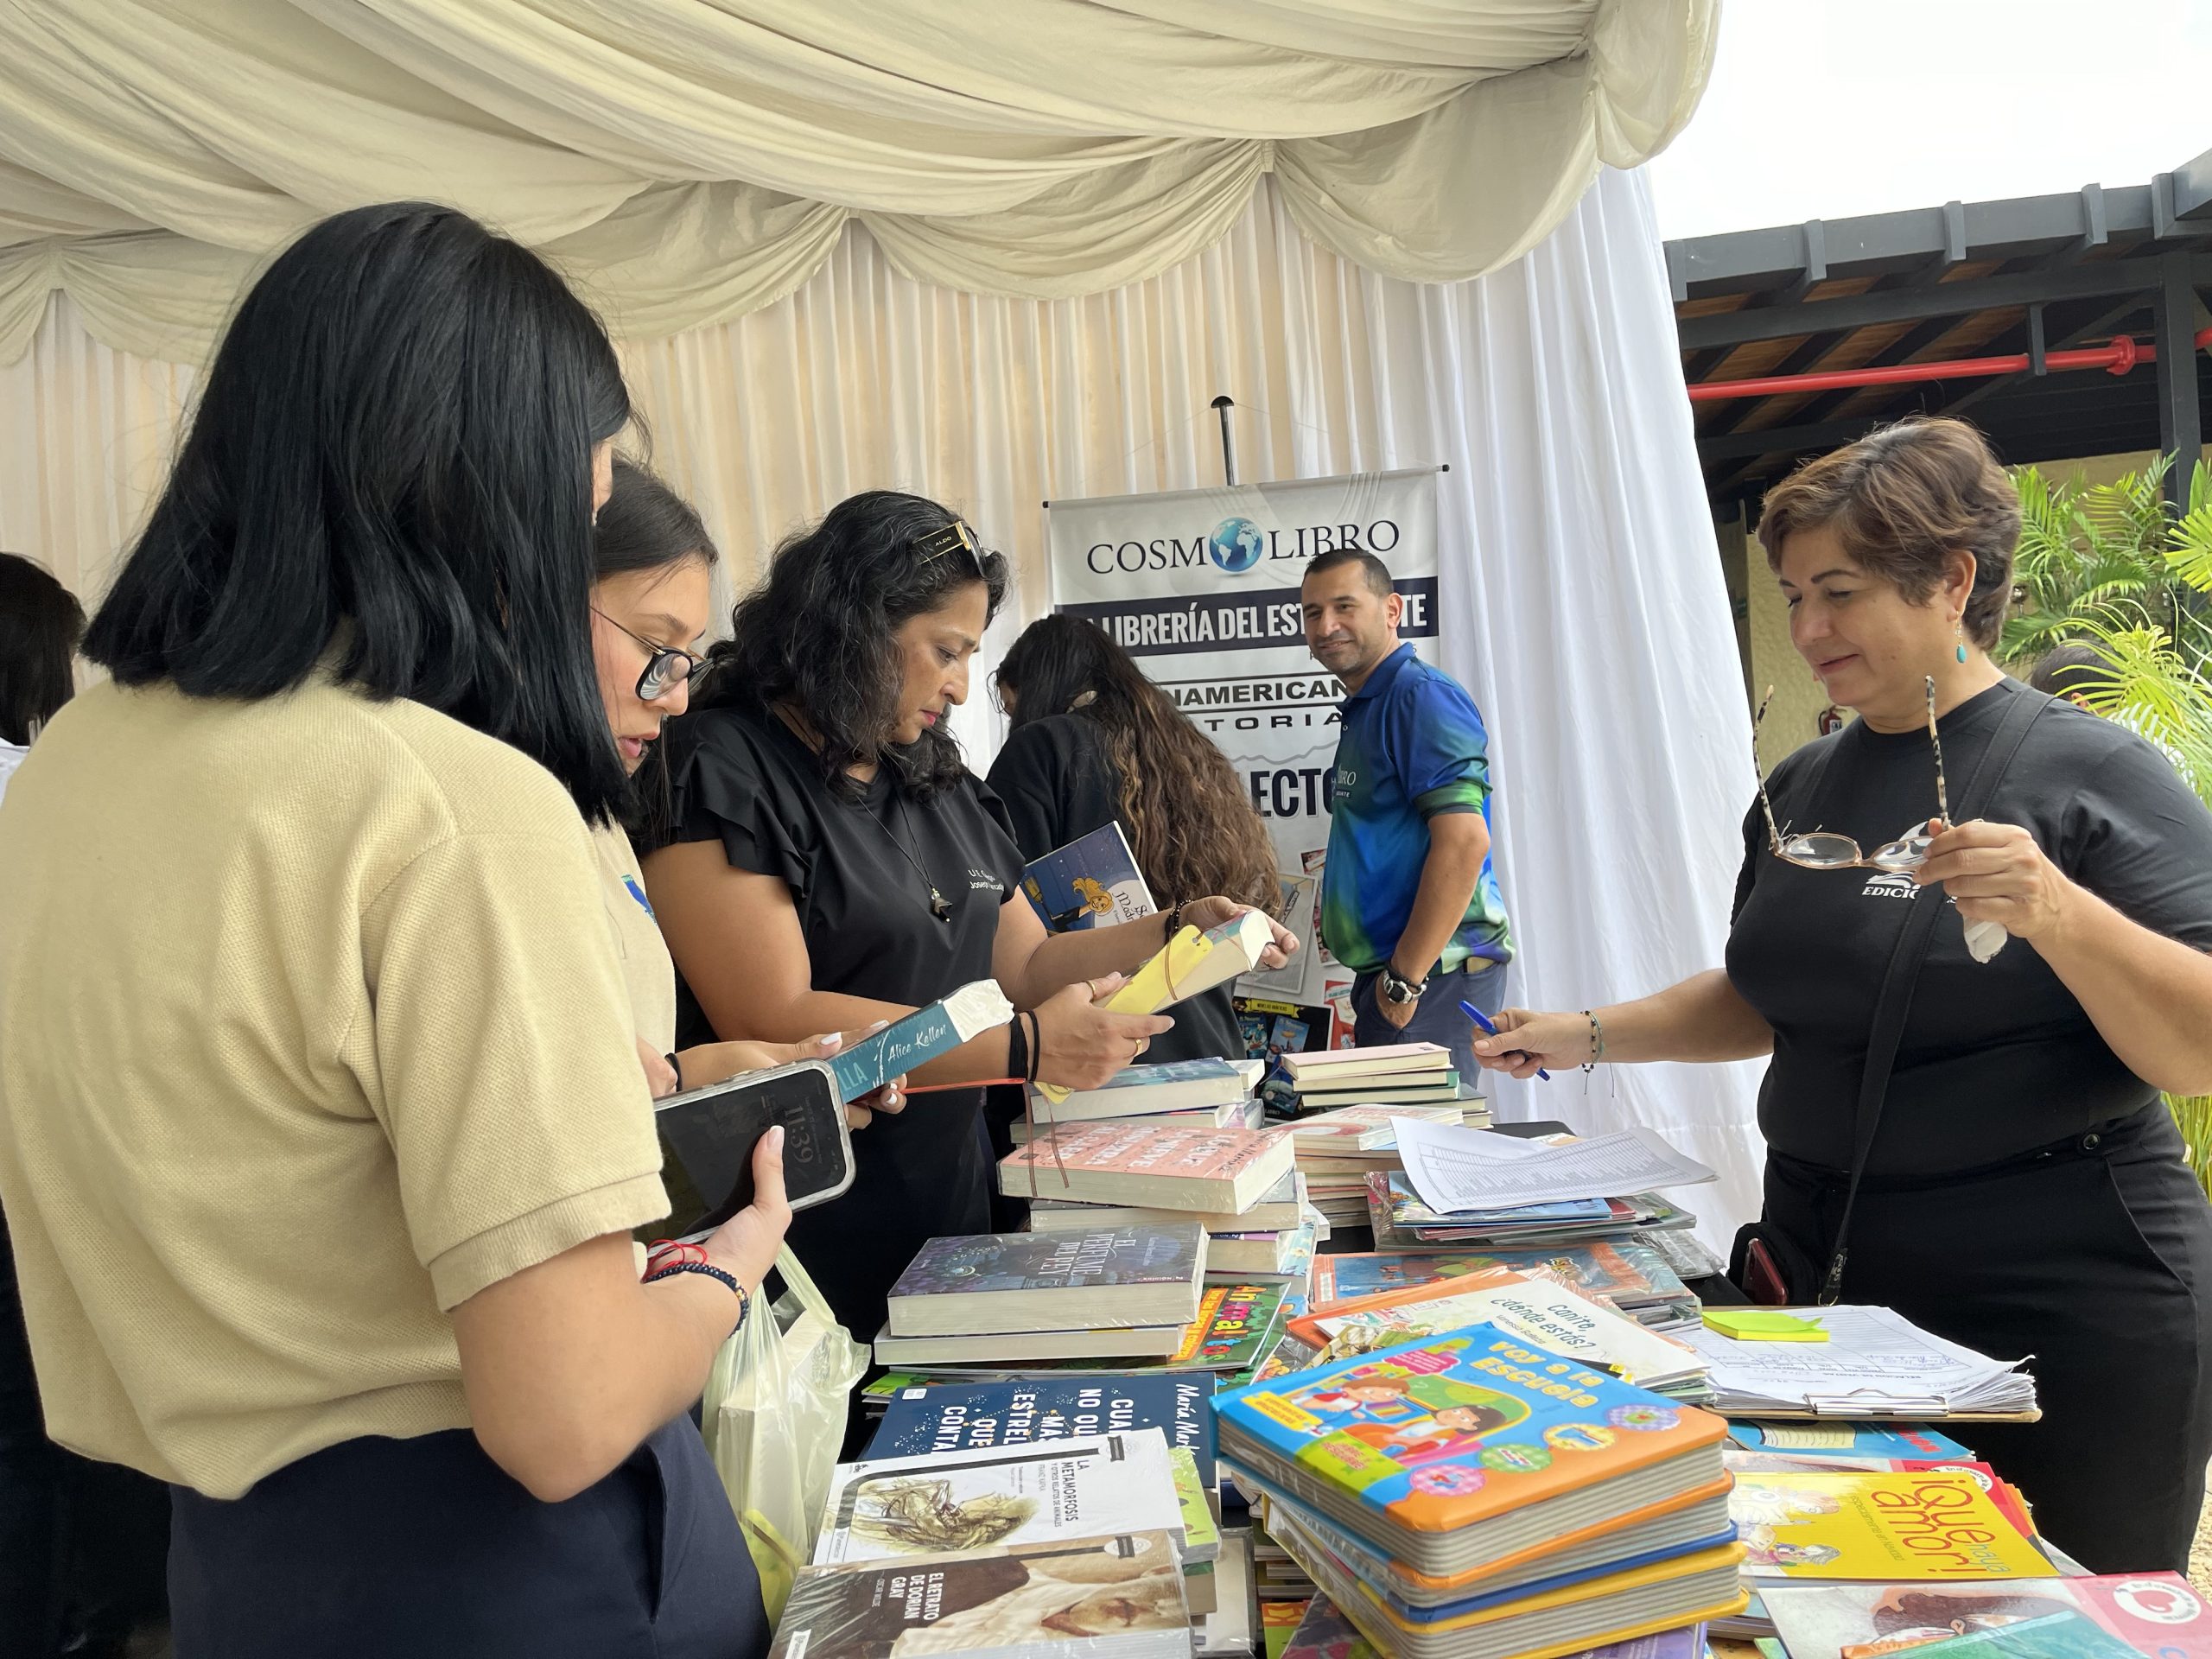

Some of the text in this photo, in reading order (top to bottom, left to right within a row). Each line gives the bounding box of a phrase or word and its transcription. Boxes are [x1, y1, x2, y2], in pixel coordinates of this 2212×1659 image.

[935, 536, 952, 547] ALDO
[1218, 606, 1264, 640] DEL
[887, 1024, 947, 1062] Alice Kellen
[785, 1106, 814, 1163] 11:39
[1038, 1242, 1081, 1275] DEL REY
[1071, 1233, 1116, 1276] PERFUME
[1113, 1238, 1137, 1249] EL
[1203, 1300, 1217, 1309] las
[1490, 1298, 1597, 1350] ¿dónde estás?
[1470, 1356, 1599, 1408] Escuela
[1567, 1371, 1605, 1388] la
[1077, 1388, 1103, 1408] NO
[1175, 1383, 1200, 1420] María
[1003, 1393, 1037, 1445] ESTREL
[1038, 1415, 1070, 1441] MÁ
[1109, 1398, 1135, 1433] CUA
[968, 1418, 998, 1447] QUE
[1051, 1466, 1059, 1480] OTROS
[1077, 1459, 1090, 1471] LA
[1052, 1481, 1060, 1499] RELATOS
[1061, 1461, 1079, 1522] METAMORFOSIS
[1053, 1506, 1062, 1528] ANIMALES
[1871, 1491, 1987, 1573] amor!
[888, 1576, 907, 1599] GRAY
[903, 1574, 925, 1619] DE DORIAN
[923, 1572, 944, 1621] EL RETRATO
